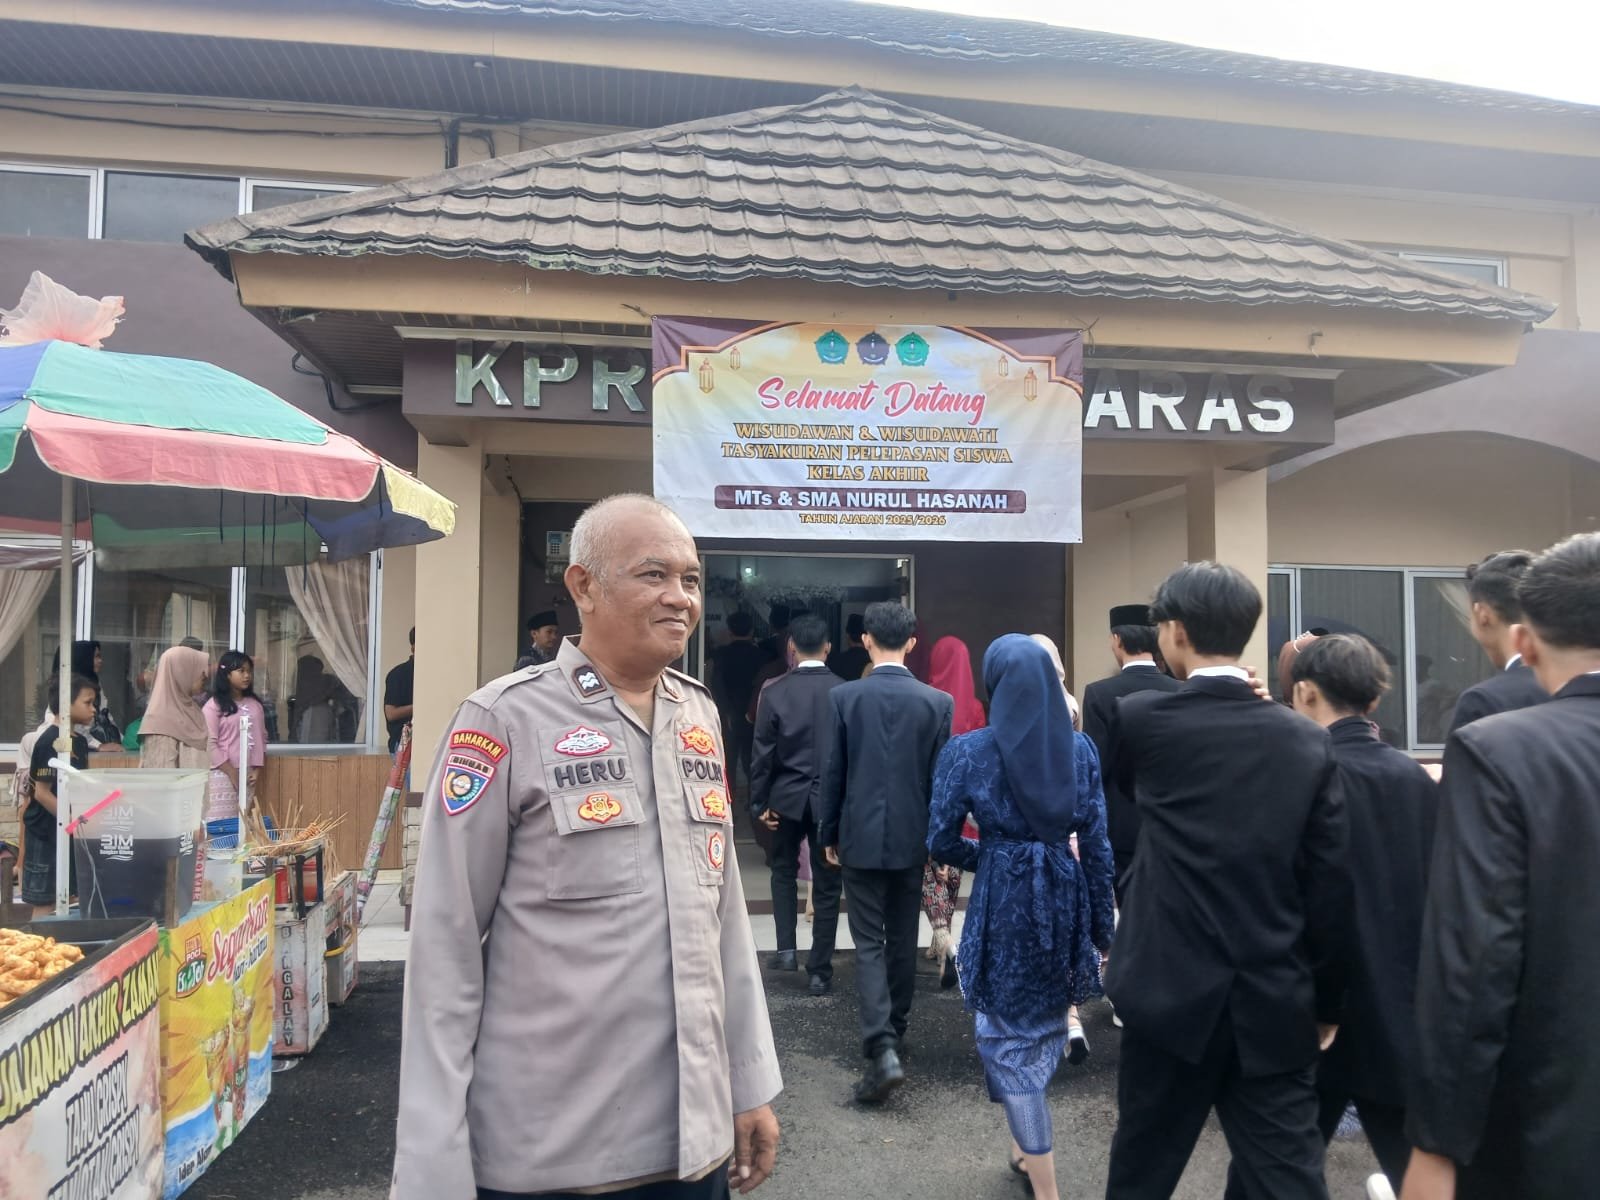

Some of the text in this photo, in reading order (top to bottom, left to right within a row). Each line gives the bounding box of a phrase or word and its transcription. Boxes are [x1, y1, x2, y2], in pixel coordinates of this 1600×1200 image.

[757, 376, 987, 425] Selamat Datang
[733, 423, 999, 443] WISUDAWAN & WISUDAWATI
[721, 442, 1013, 463] TASYAKURAN PELEPASAN SISWA
[807, 464, 930, 481] KELAS AKHIR
[735, 489, 1008, 509] MTs & SMA NURUL HASANAH
[799, 513, 947, 526] TAHUN AJARAN 2025/2026
[453, 732, 502, 758] BAHARKAM
[554, 758, 627, 788] HERU
[79, 978, 120, 1063] AKHIR
[121, 950, 159, 1031] ZAMAN
[66, 1050, 128, 1167] TAHU CRISPY
